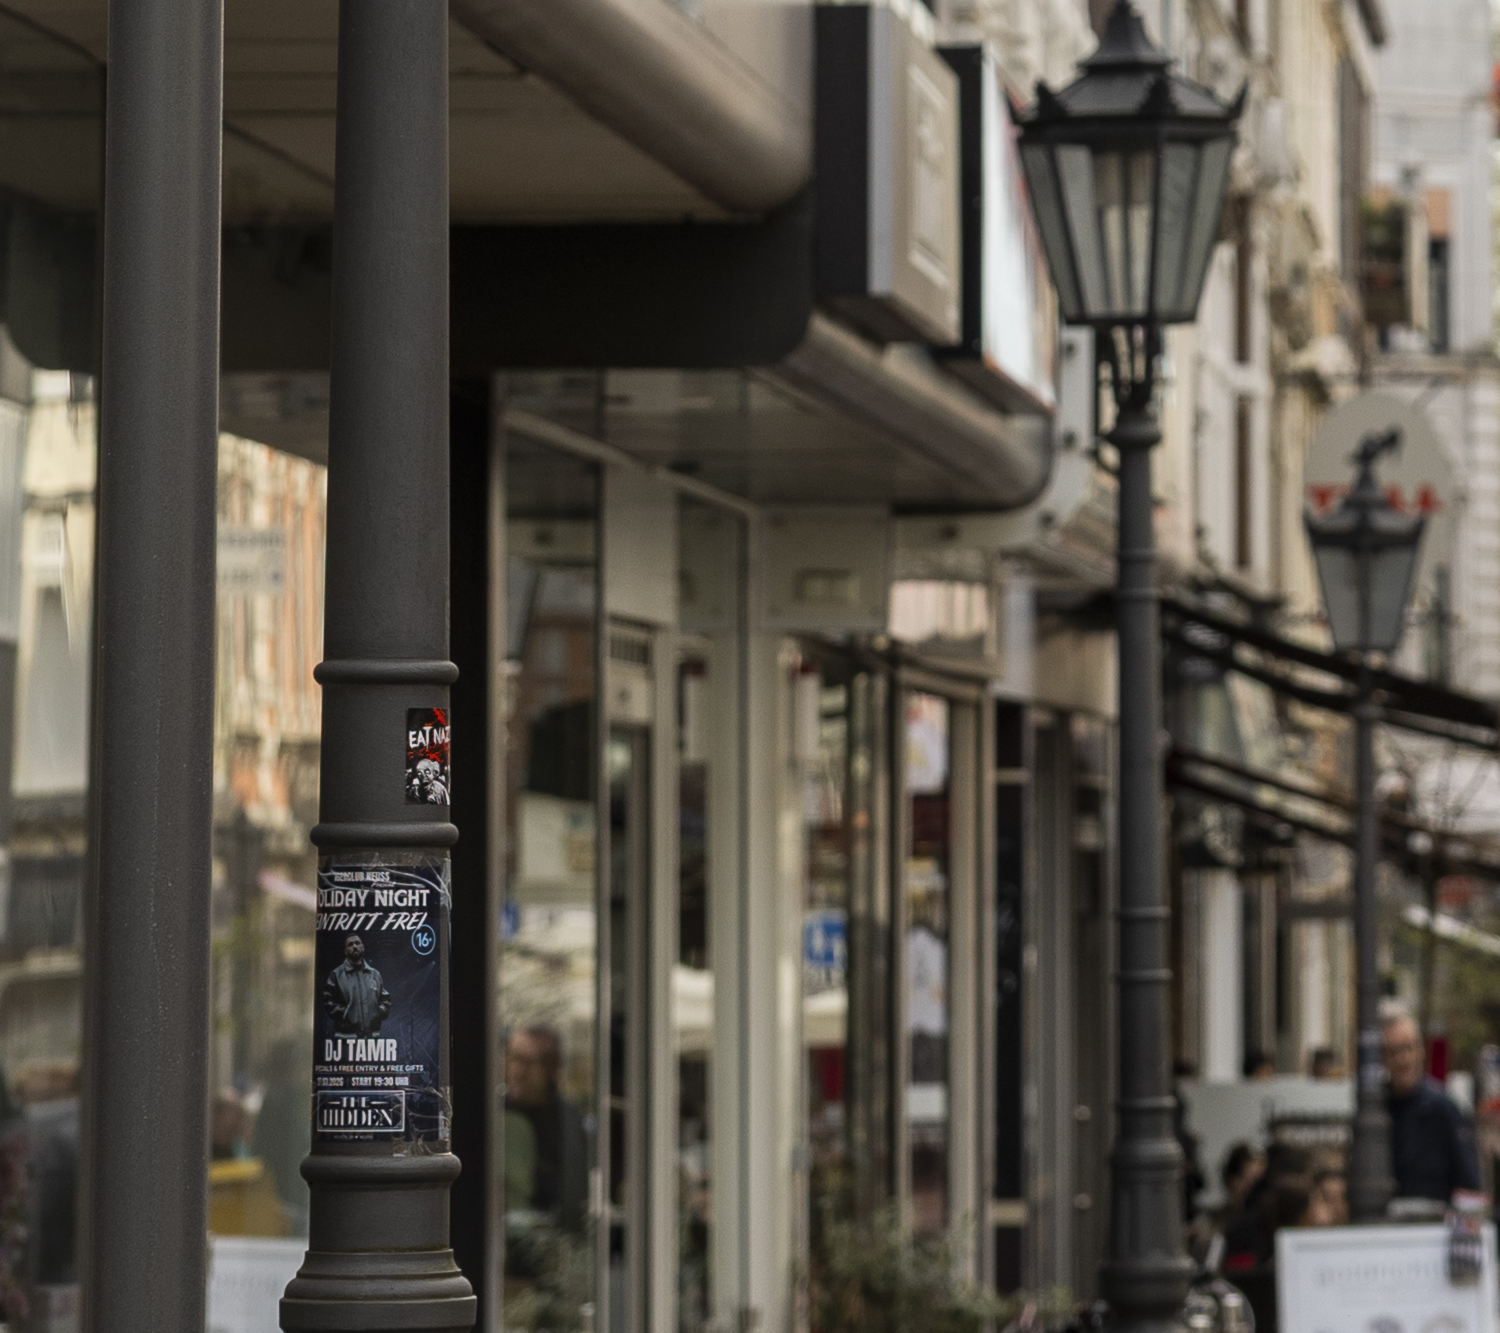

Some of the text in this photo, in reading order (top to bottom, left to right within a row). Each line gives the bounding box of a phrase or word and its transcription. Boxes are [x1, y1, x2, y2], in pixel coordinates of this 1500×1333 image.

[408, 725, 450, 749] EAT NAZ
[318, 889, 430, 907] OLIDAY NIGHT
[381, 912, 429, 931] FREI
[325, 1038, 398, 1062] DJ TAMR
[338, 1064, 354, 1072] FREE
[355, 1064, 378, 1072] ENTRY
[386, 1064, 404, 1072] FREE
[404, 1064, 424, 1072] GIFTS
[351, 1076, 373, 1087] START
[340, 1096, 370, 1108] THE
[323, 1108, 394, 1126] HIDDEN
